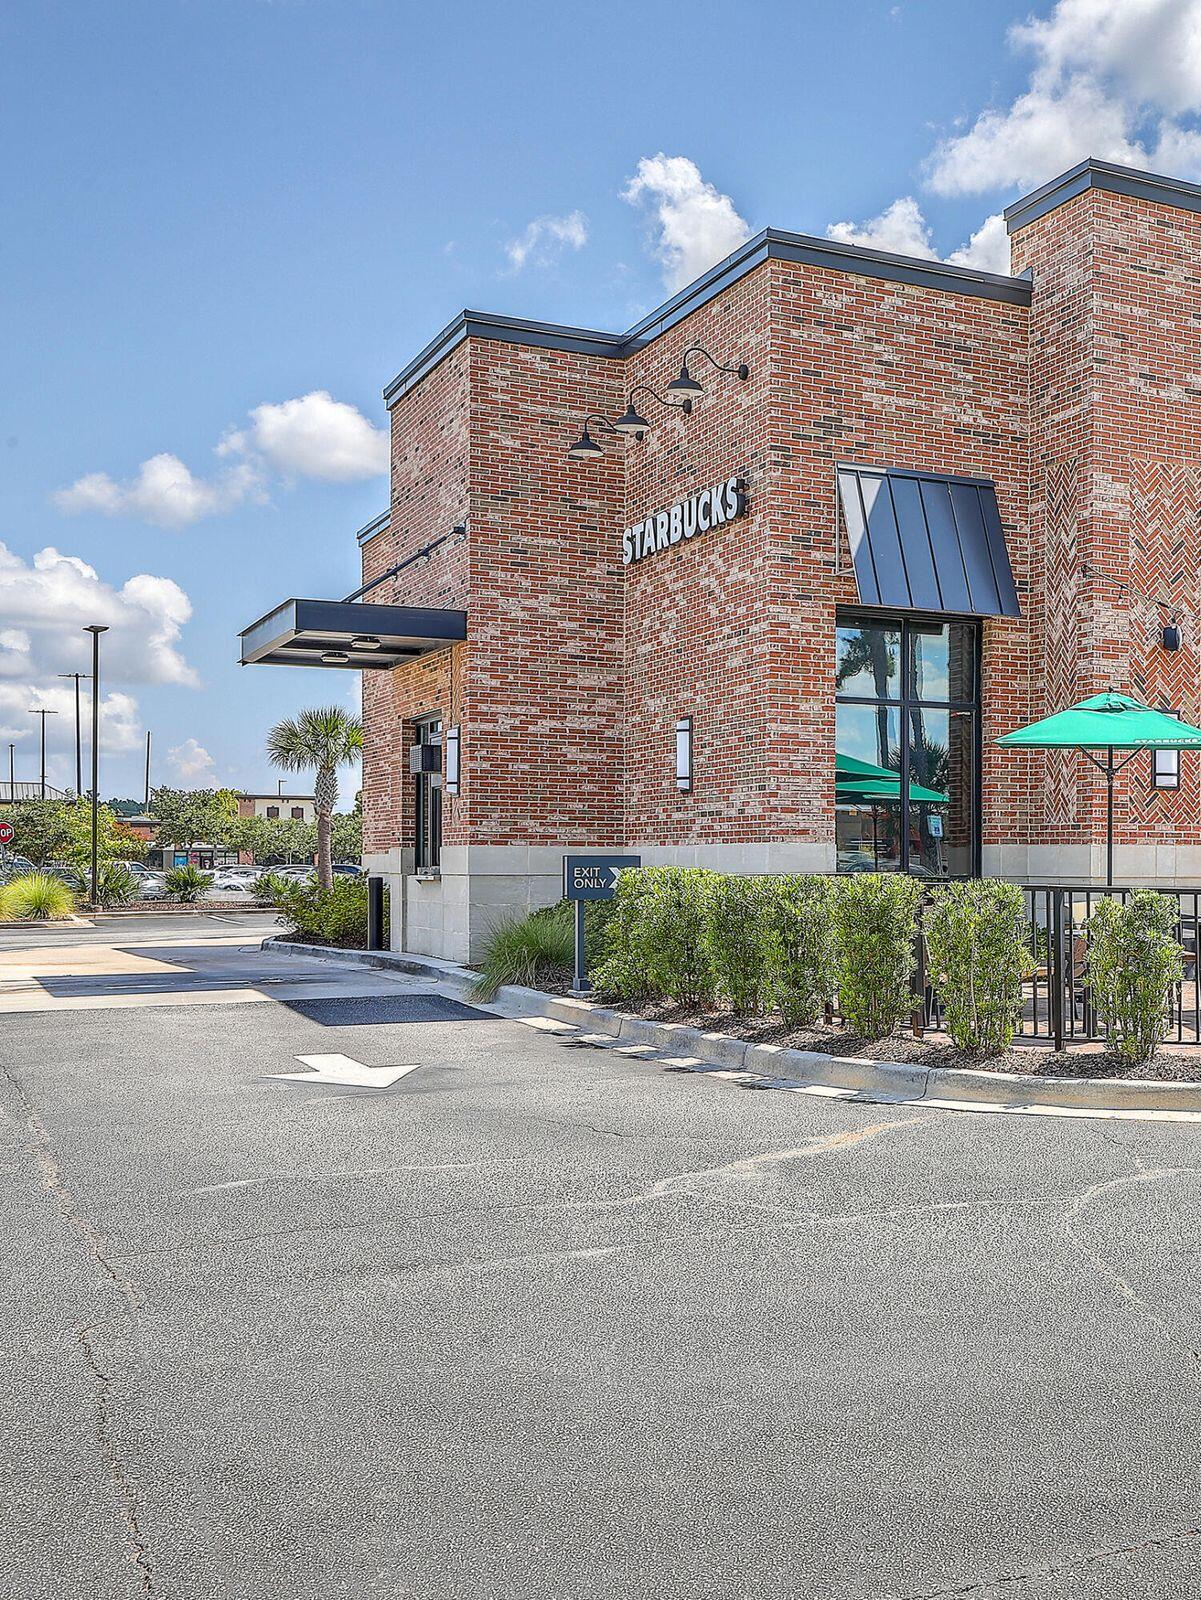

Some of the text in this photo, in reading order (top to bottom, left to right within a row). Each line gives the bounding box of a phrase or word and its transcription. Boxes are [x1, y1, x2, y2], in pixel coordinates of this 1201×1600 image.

[622, 477, 741, 565] STARBUCKS
[0, 828, 12, 837] OP
[574, 867, 600, 877] EXIT
[574, 878, 607, 888] ONLY
